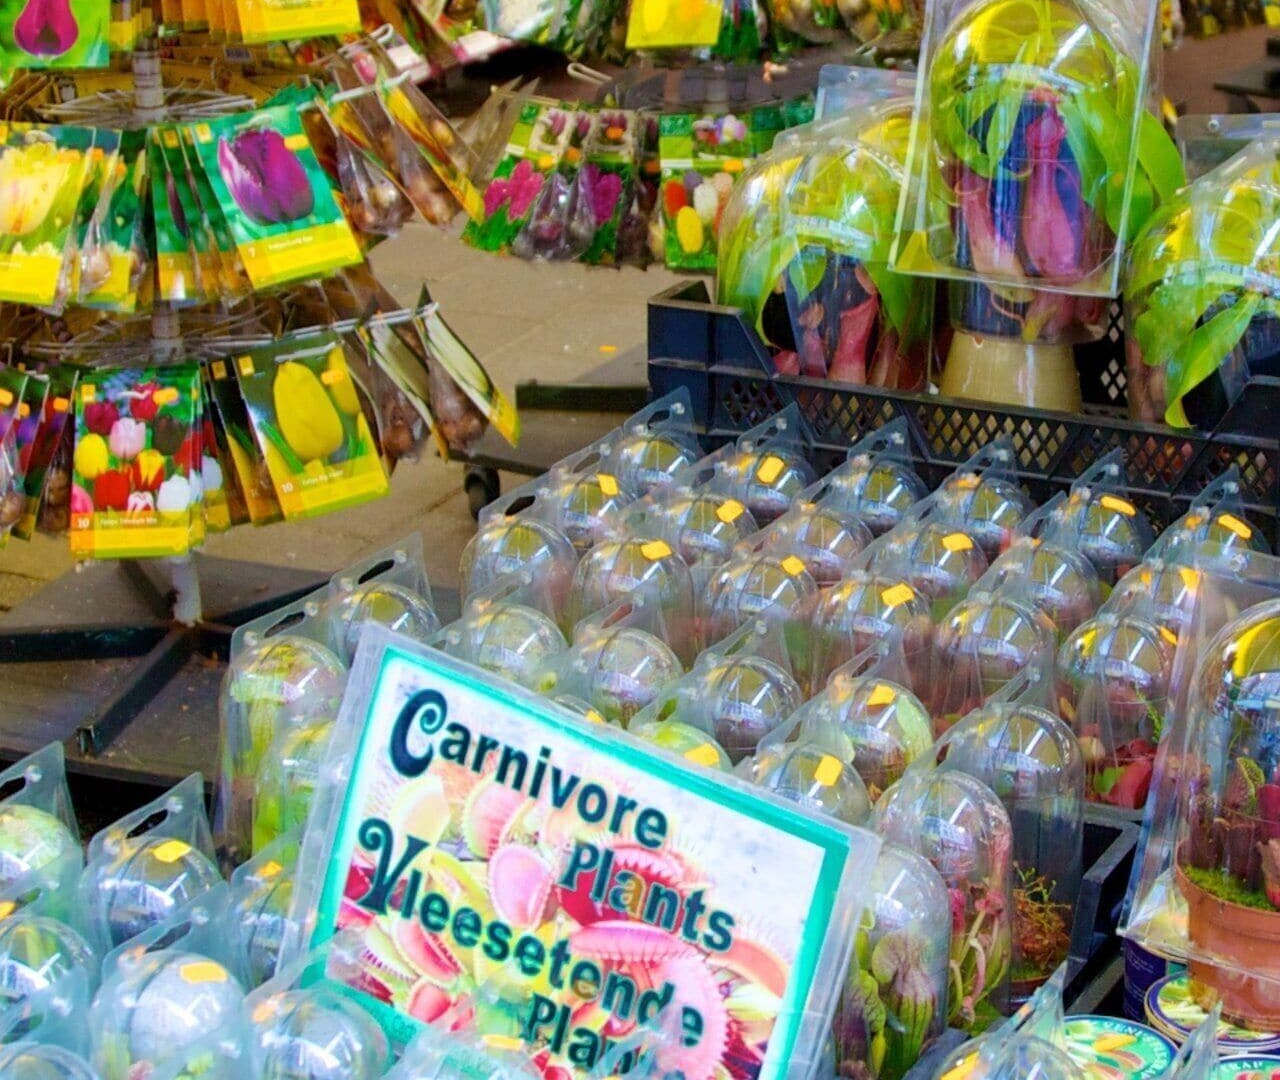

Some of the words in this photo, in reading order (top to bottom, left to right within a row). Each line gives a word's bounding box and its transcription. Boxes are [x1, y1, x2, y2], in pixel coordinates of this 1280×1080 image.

[77, 517, 90, 529] 10
[389, 689, 668, 848] Carnivore
[358, 818, 704, 1048] Vleesetende
[558, 842, 736, 953] Plants
